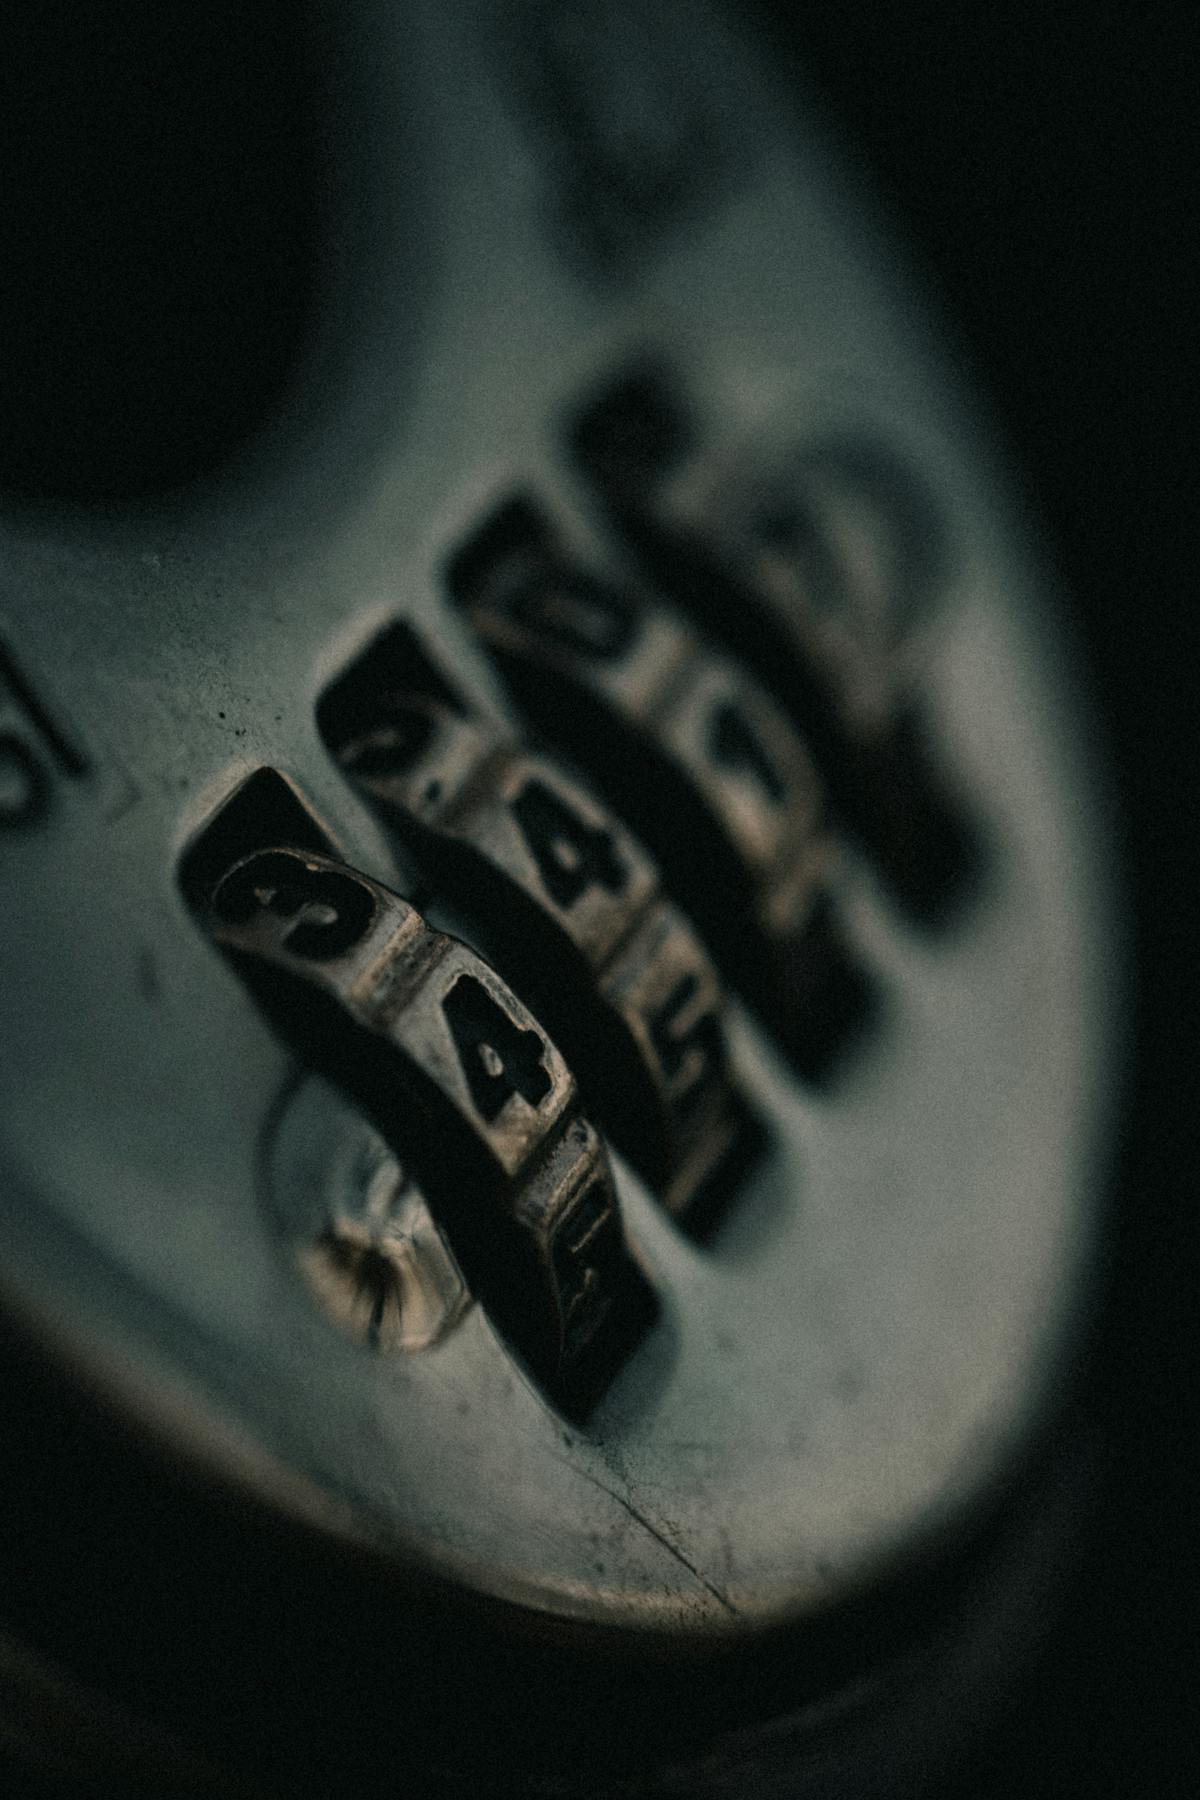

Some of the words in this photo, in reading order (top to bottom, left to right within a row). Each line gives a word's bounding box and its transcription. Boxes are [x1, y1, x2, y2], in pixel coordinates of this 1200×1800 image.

[512, 776, 629, 909] 4
[213, 850, 376, 961] 3
[441, 973, 553, 1124] 4
